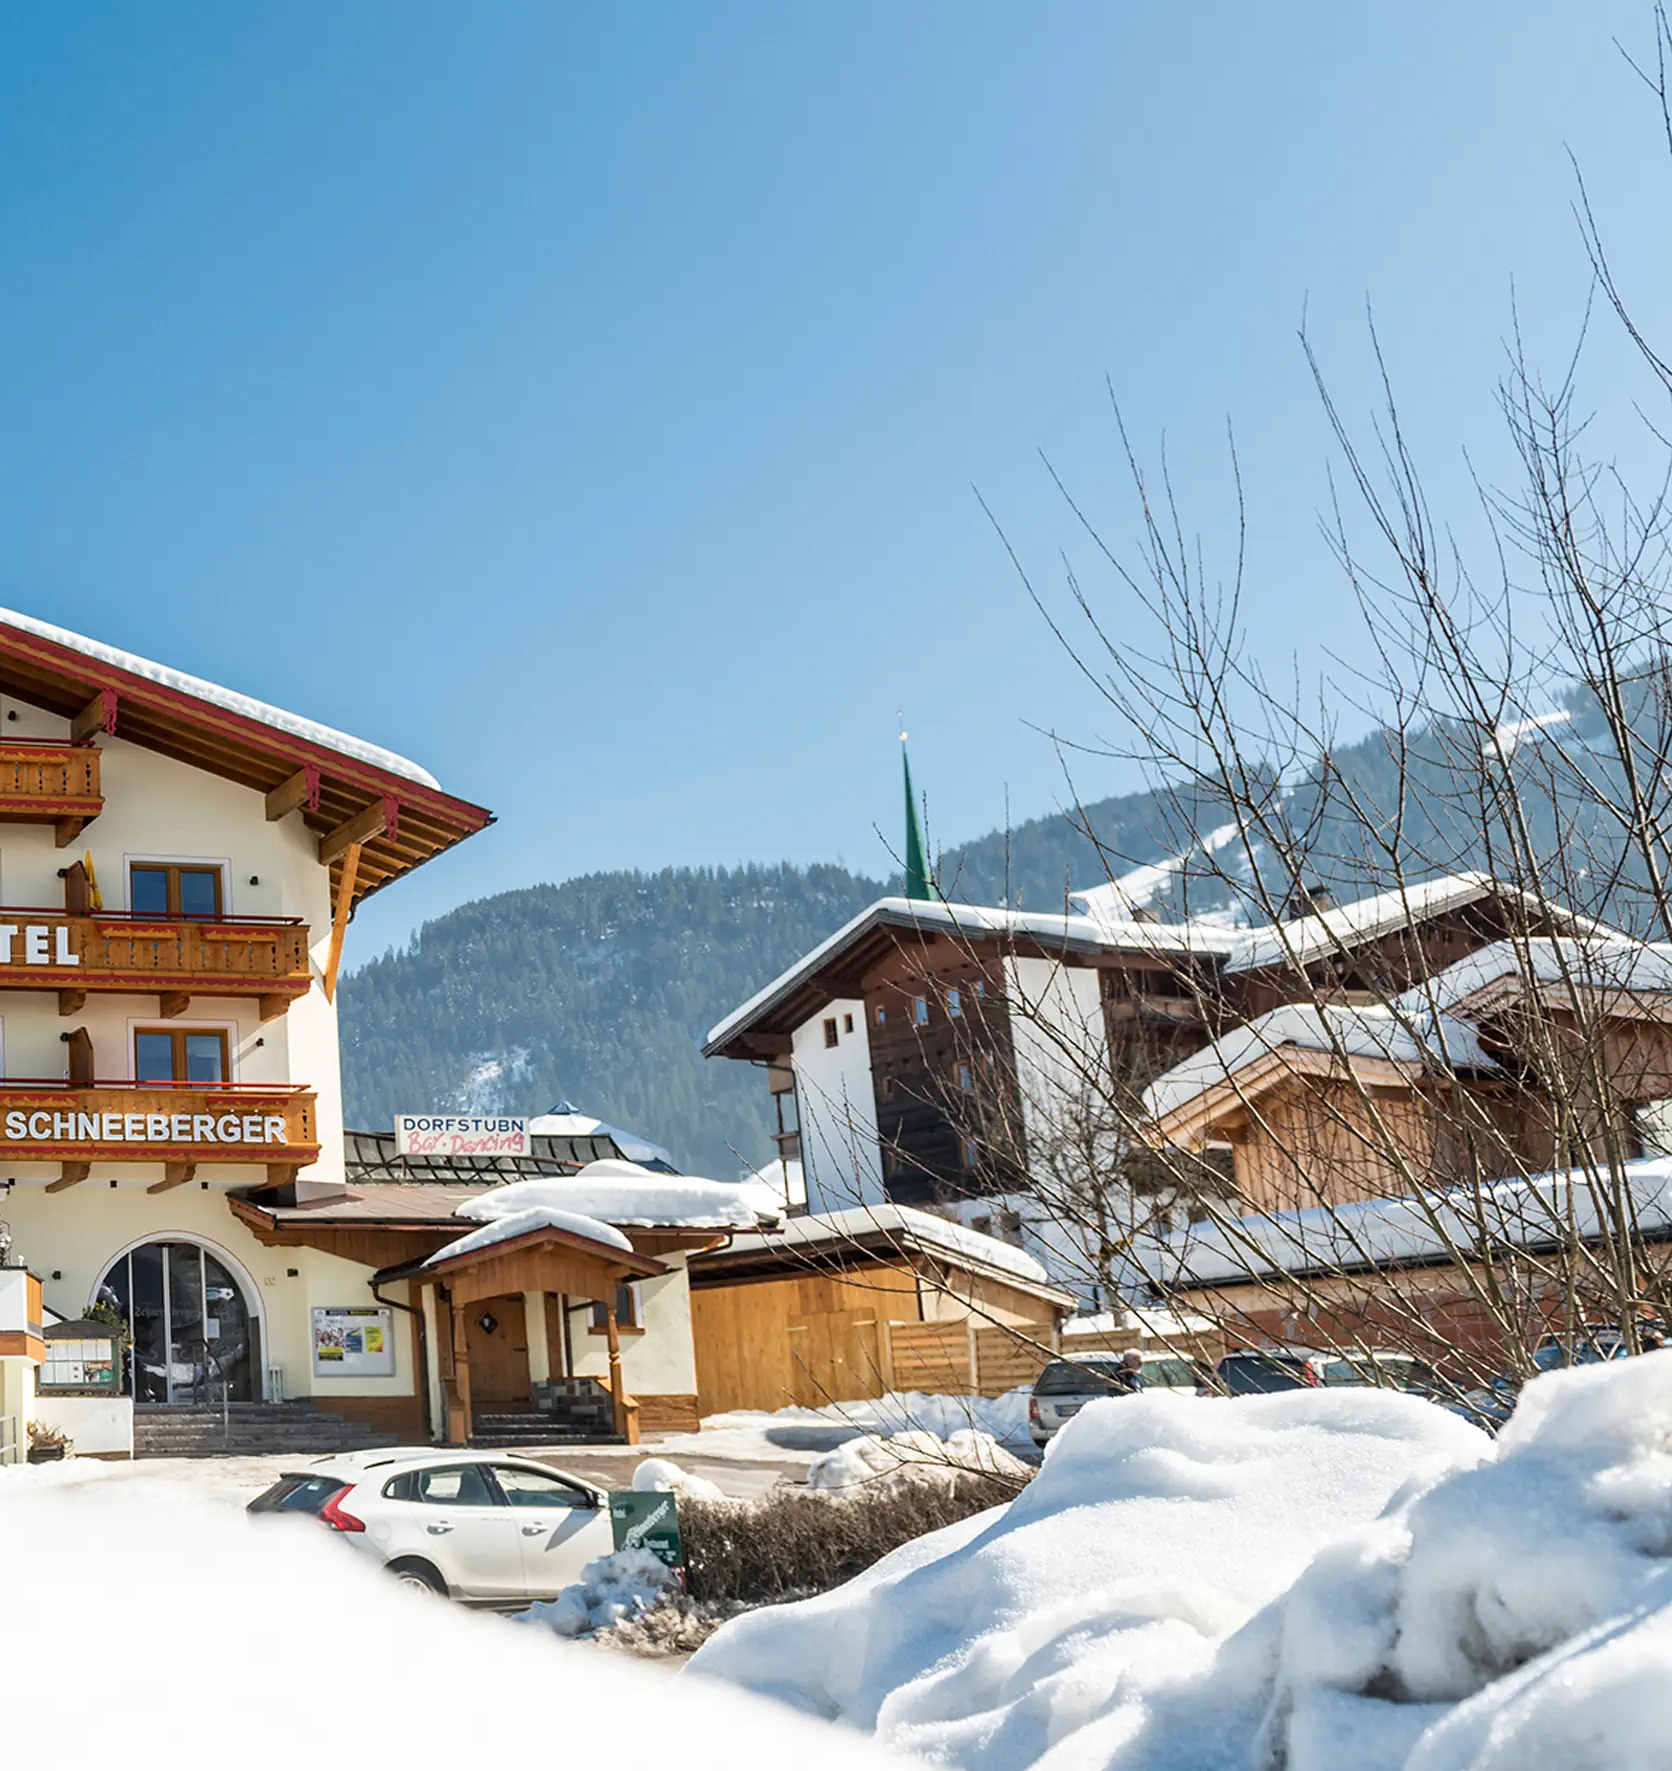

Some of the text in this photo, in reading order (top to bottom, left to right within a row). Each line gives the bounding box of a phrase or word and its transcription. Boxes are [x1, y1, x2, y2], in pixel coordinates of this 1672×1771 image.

[4, 1111, 288, 1144] SCHNEEBERGER
[403, 1118, 524, 1132] DORFSTUBN
[449, 1131, 525, 1155] Dancing
